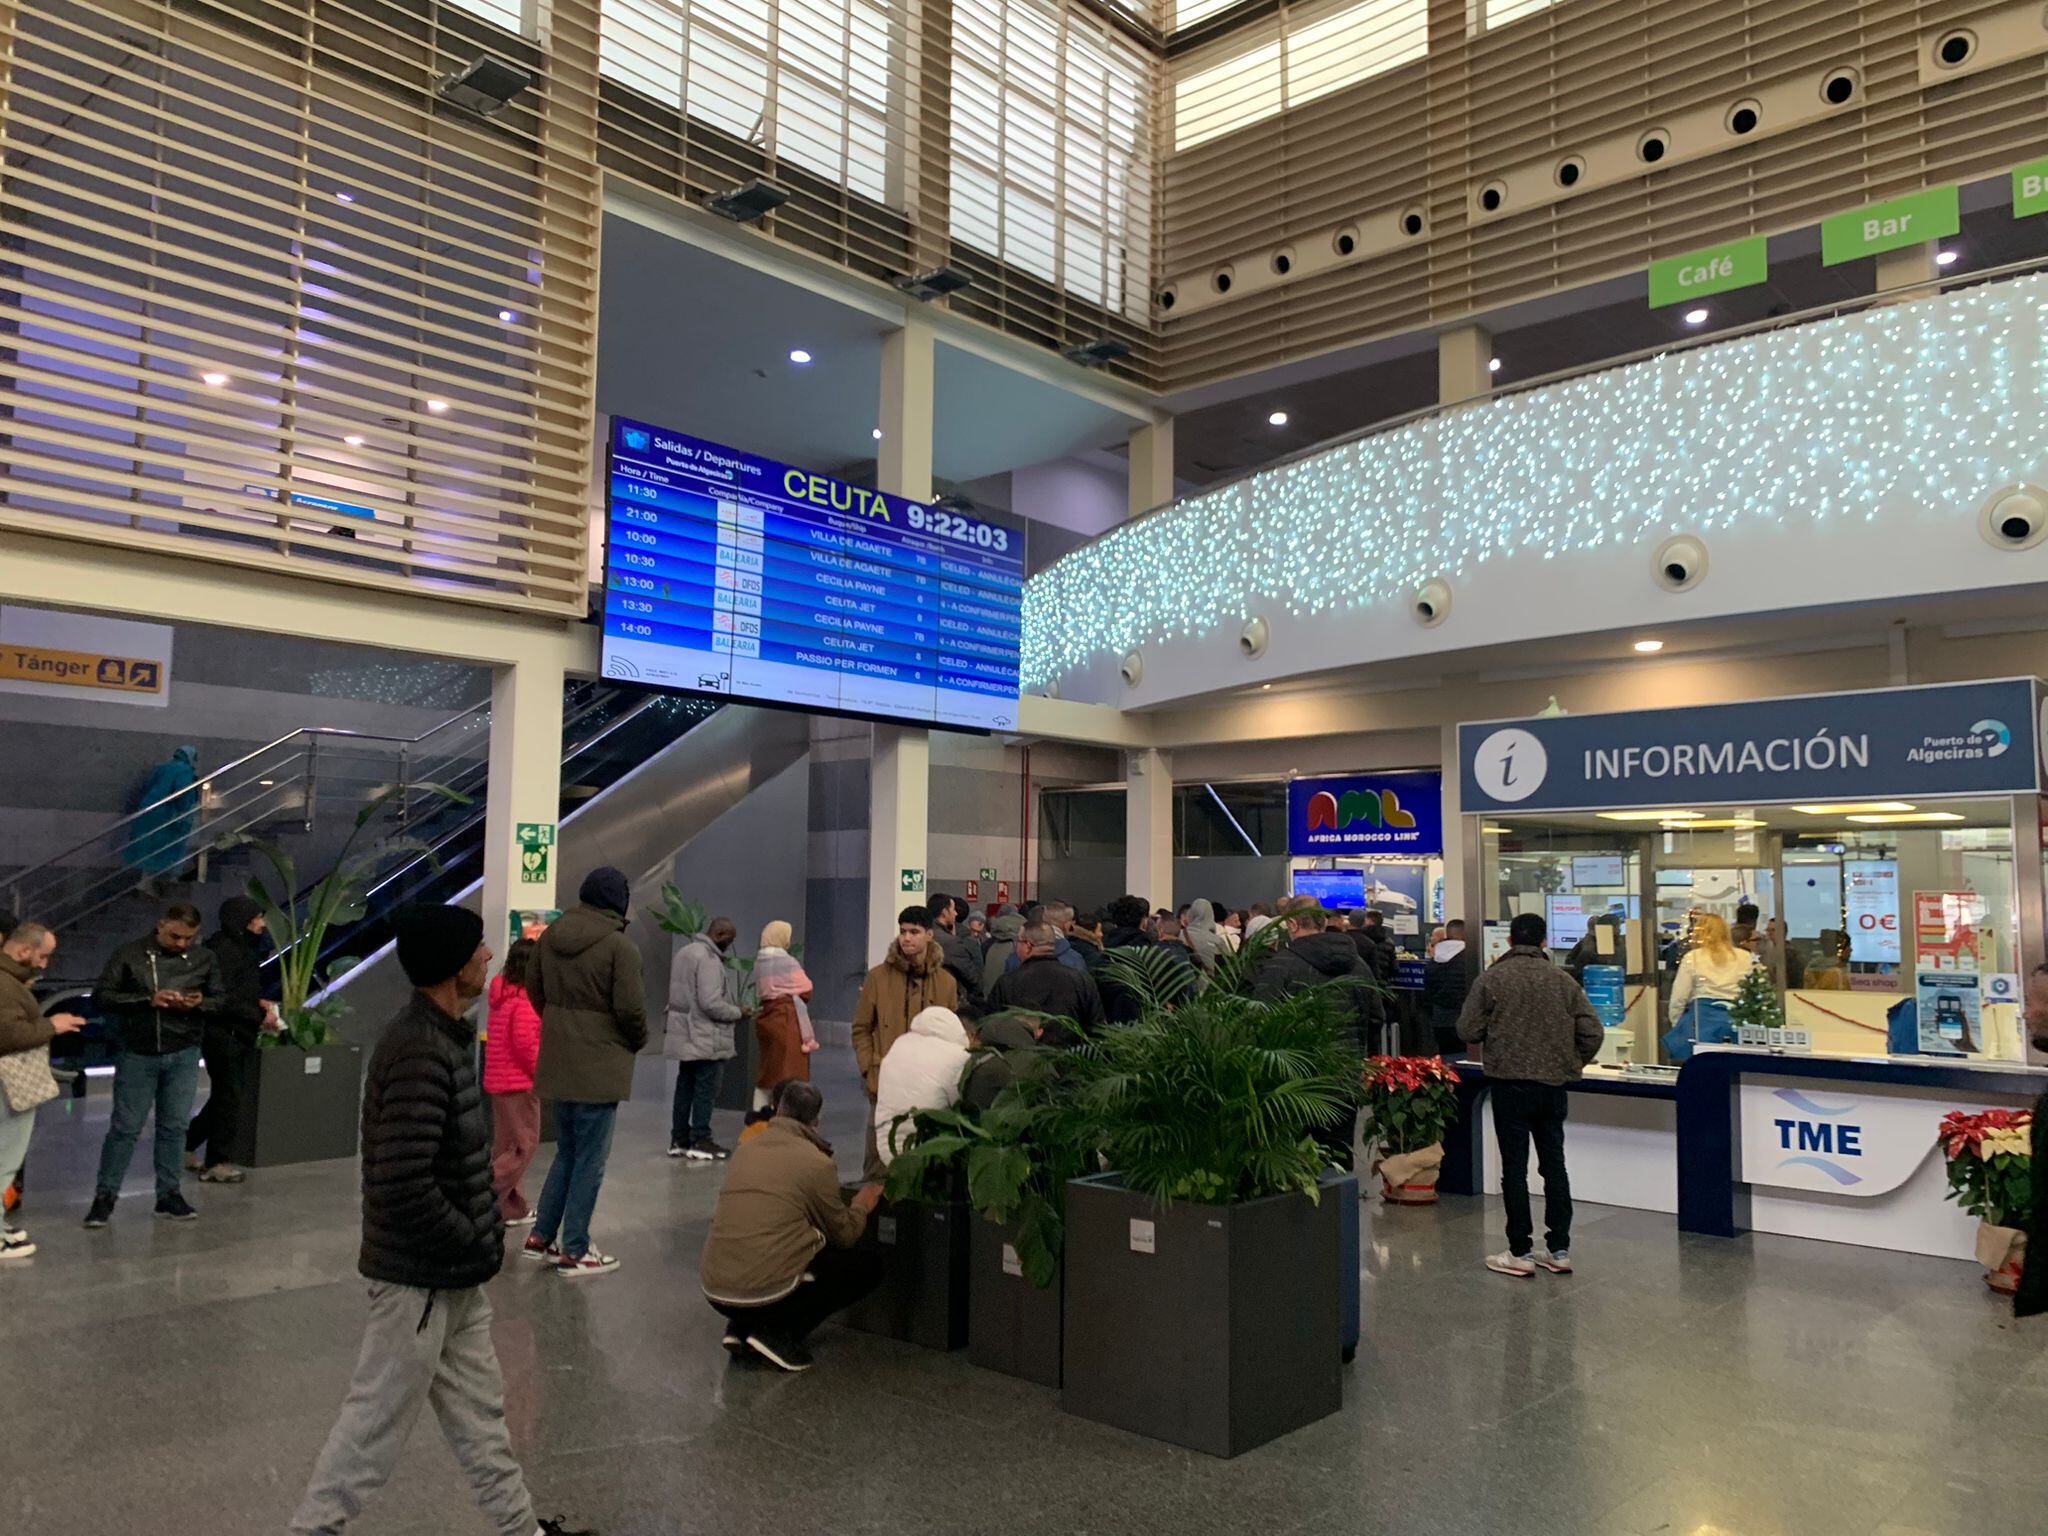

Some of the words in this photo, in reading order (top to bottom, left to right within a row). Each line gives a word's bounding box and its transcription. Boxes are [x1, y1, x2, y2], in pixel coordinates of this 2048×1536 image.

[1863, 213, 1912, 241] Bar
[1678, 255, 1734, 287] Café
[654, 437, 692, 457] Salidas
[703, 451, 761, 477] Departures
[620, 464, 640, 476] Hora
[649, 472, 668, 483] Time
[627, 483, 657, 499] 11:30
[783, 469, 891, 522] CEUTA
[626, 507, 657, 523] 21:00
[810, 528, 838, 544] VILLA
[907, 504, 1009, 552] 9:22:03
[625, 530, 656, 545] 10:00
[624, 552, 655, 568] 10:30
[810, 551, 838, 565] VILLA
[623, 575, 654, 590] 13:00
[815, 572, 853, 589] CECILIA
[855, 581, 885, 596] PAYNE
[622, 599, 652, 613] 13:30
[824, 594, 857, 609] CEUTA
[858, 601, 875, 613] JET
[620, 622, 651, 636] 14:00
[814, 613, 852, 628] CECILIA
[853, 620, 884, 634] PAYNE
[823, 636, 855, 650] CEUTA
[857, 642, 874, 653] JET
[15, 653, 90, 676] Tánger
[796, 651, 832, 666] PASSIO
[834, 658, 854, 669] PER
[857, 661, 897, 676] FORMEN
[1923, 736, 1964, 748] Puerto
[1967, 734, 1982, 745] de
[1583, 727, 1868, 780] INFORMACIÓN
[1907, 746, 1984, 763] Algeciras
[1307, 789, 1417, 831] AML
[1308, 834, 1342, 843] AFRICA
[1343, 832, 1392, 842] MOROCCO
[1394, 831, 1418, 841] LINK
[523, 873, 546, 881] DEA
[1774, 1119, 1862, 1156] TME
